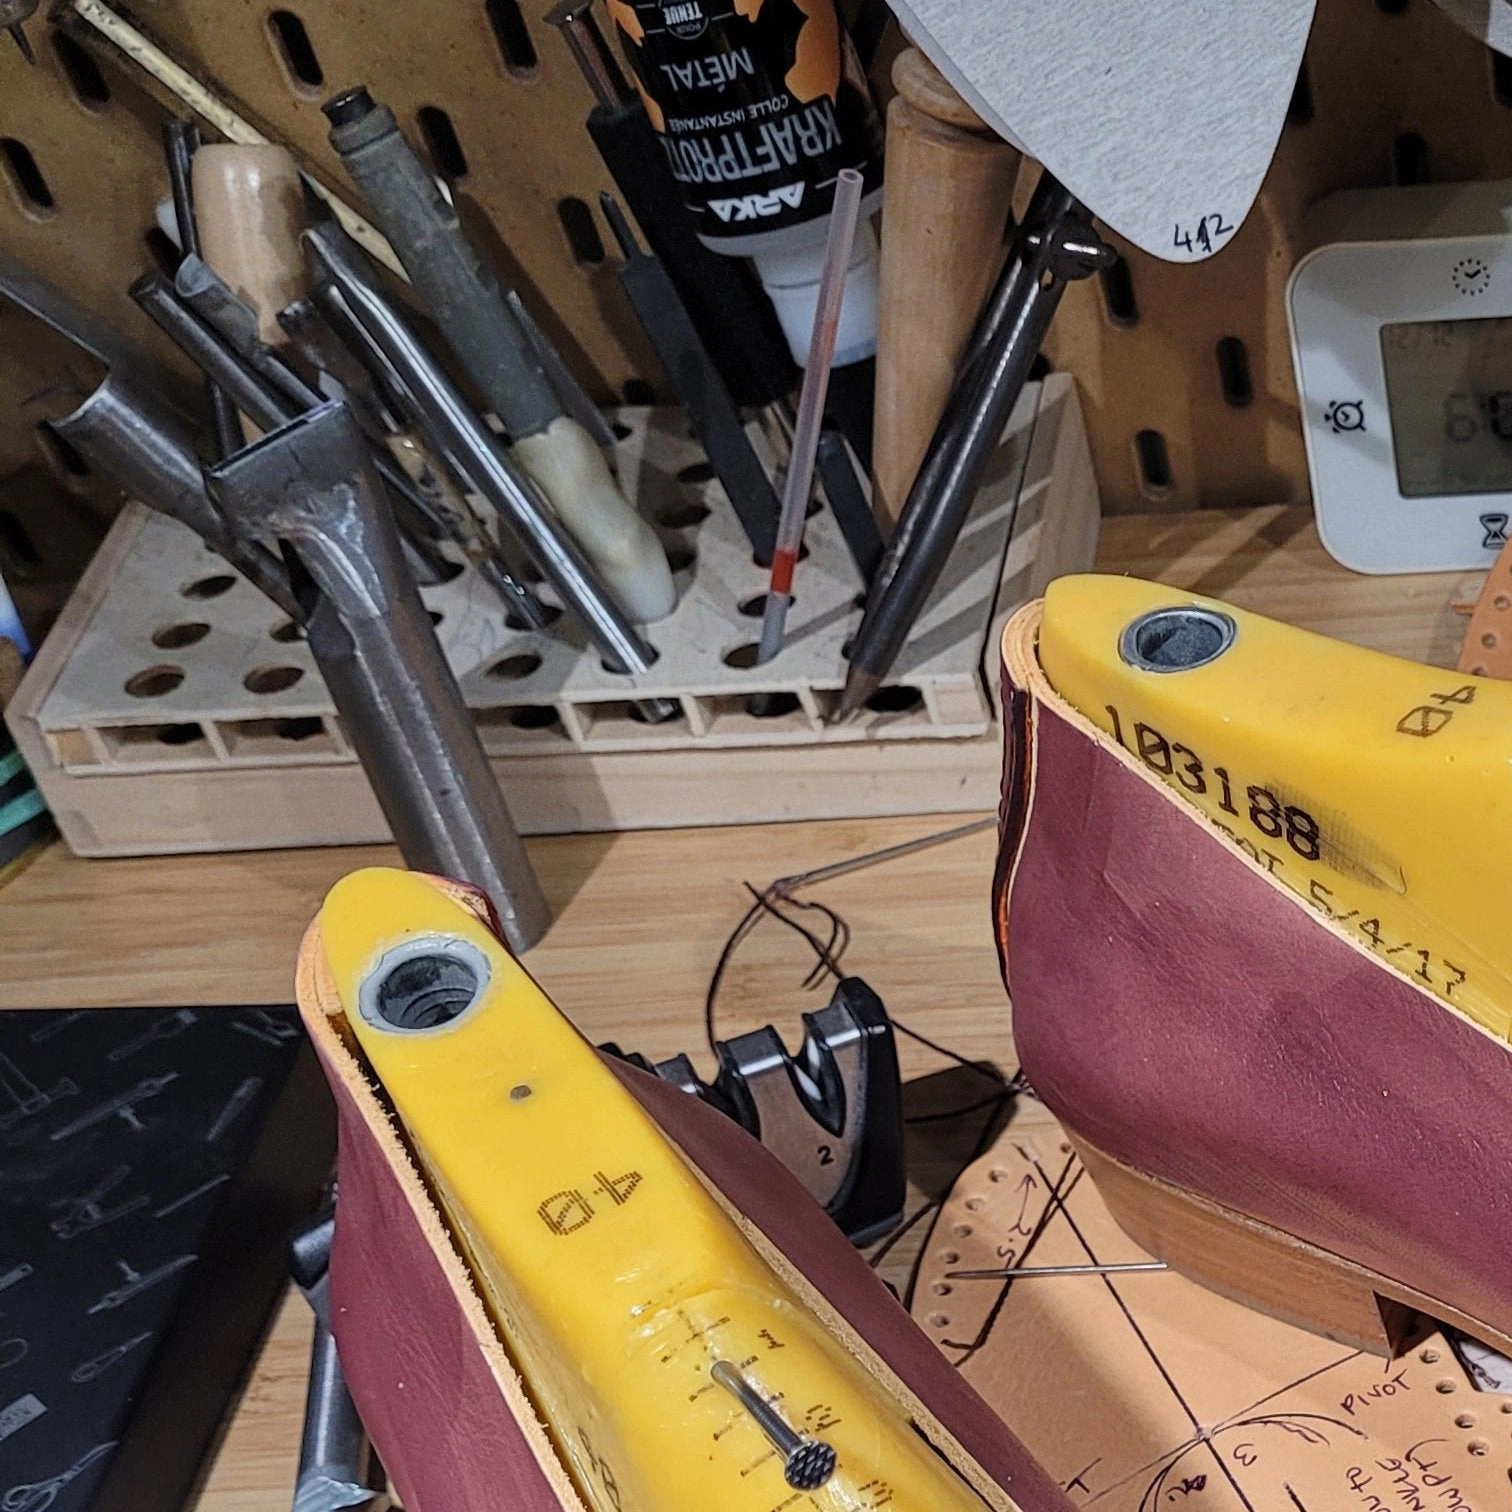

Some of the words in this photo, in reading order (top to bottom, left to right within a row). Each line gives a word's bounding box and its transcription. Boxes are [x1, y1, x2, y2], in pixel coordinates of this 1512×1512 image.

[664, 1, 704, 25] TENUE
[660, 47, 755, 93] MÉTAL
[668, 109, 746, 133] INSTANTANÉE
[749, 94, 790, 119] COLLE
[706, 181, 806, 222] ARKA
[1105, 704, 1320, 861] 103188
[817, 1145, 835, 1166] 2
[1340, 1369, 1411, 1415] PIVOT
